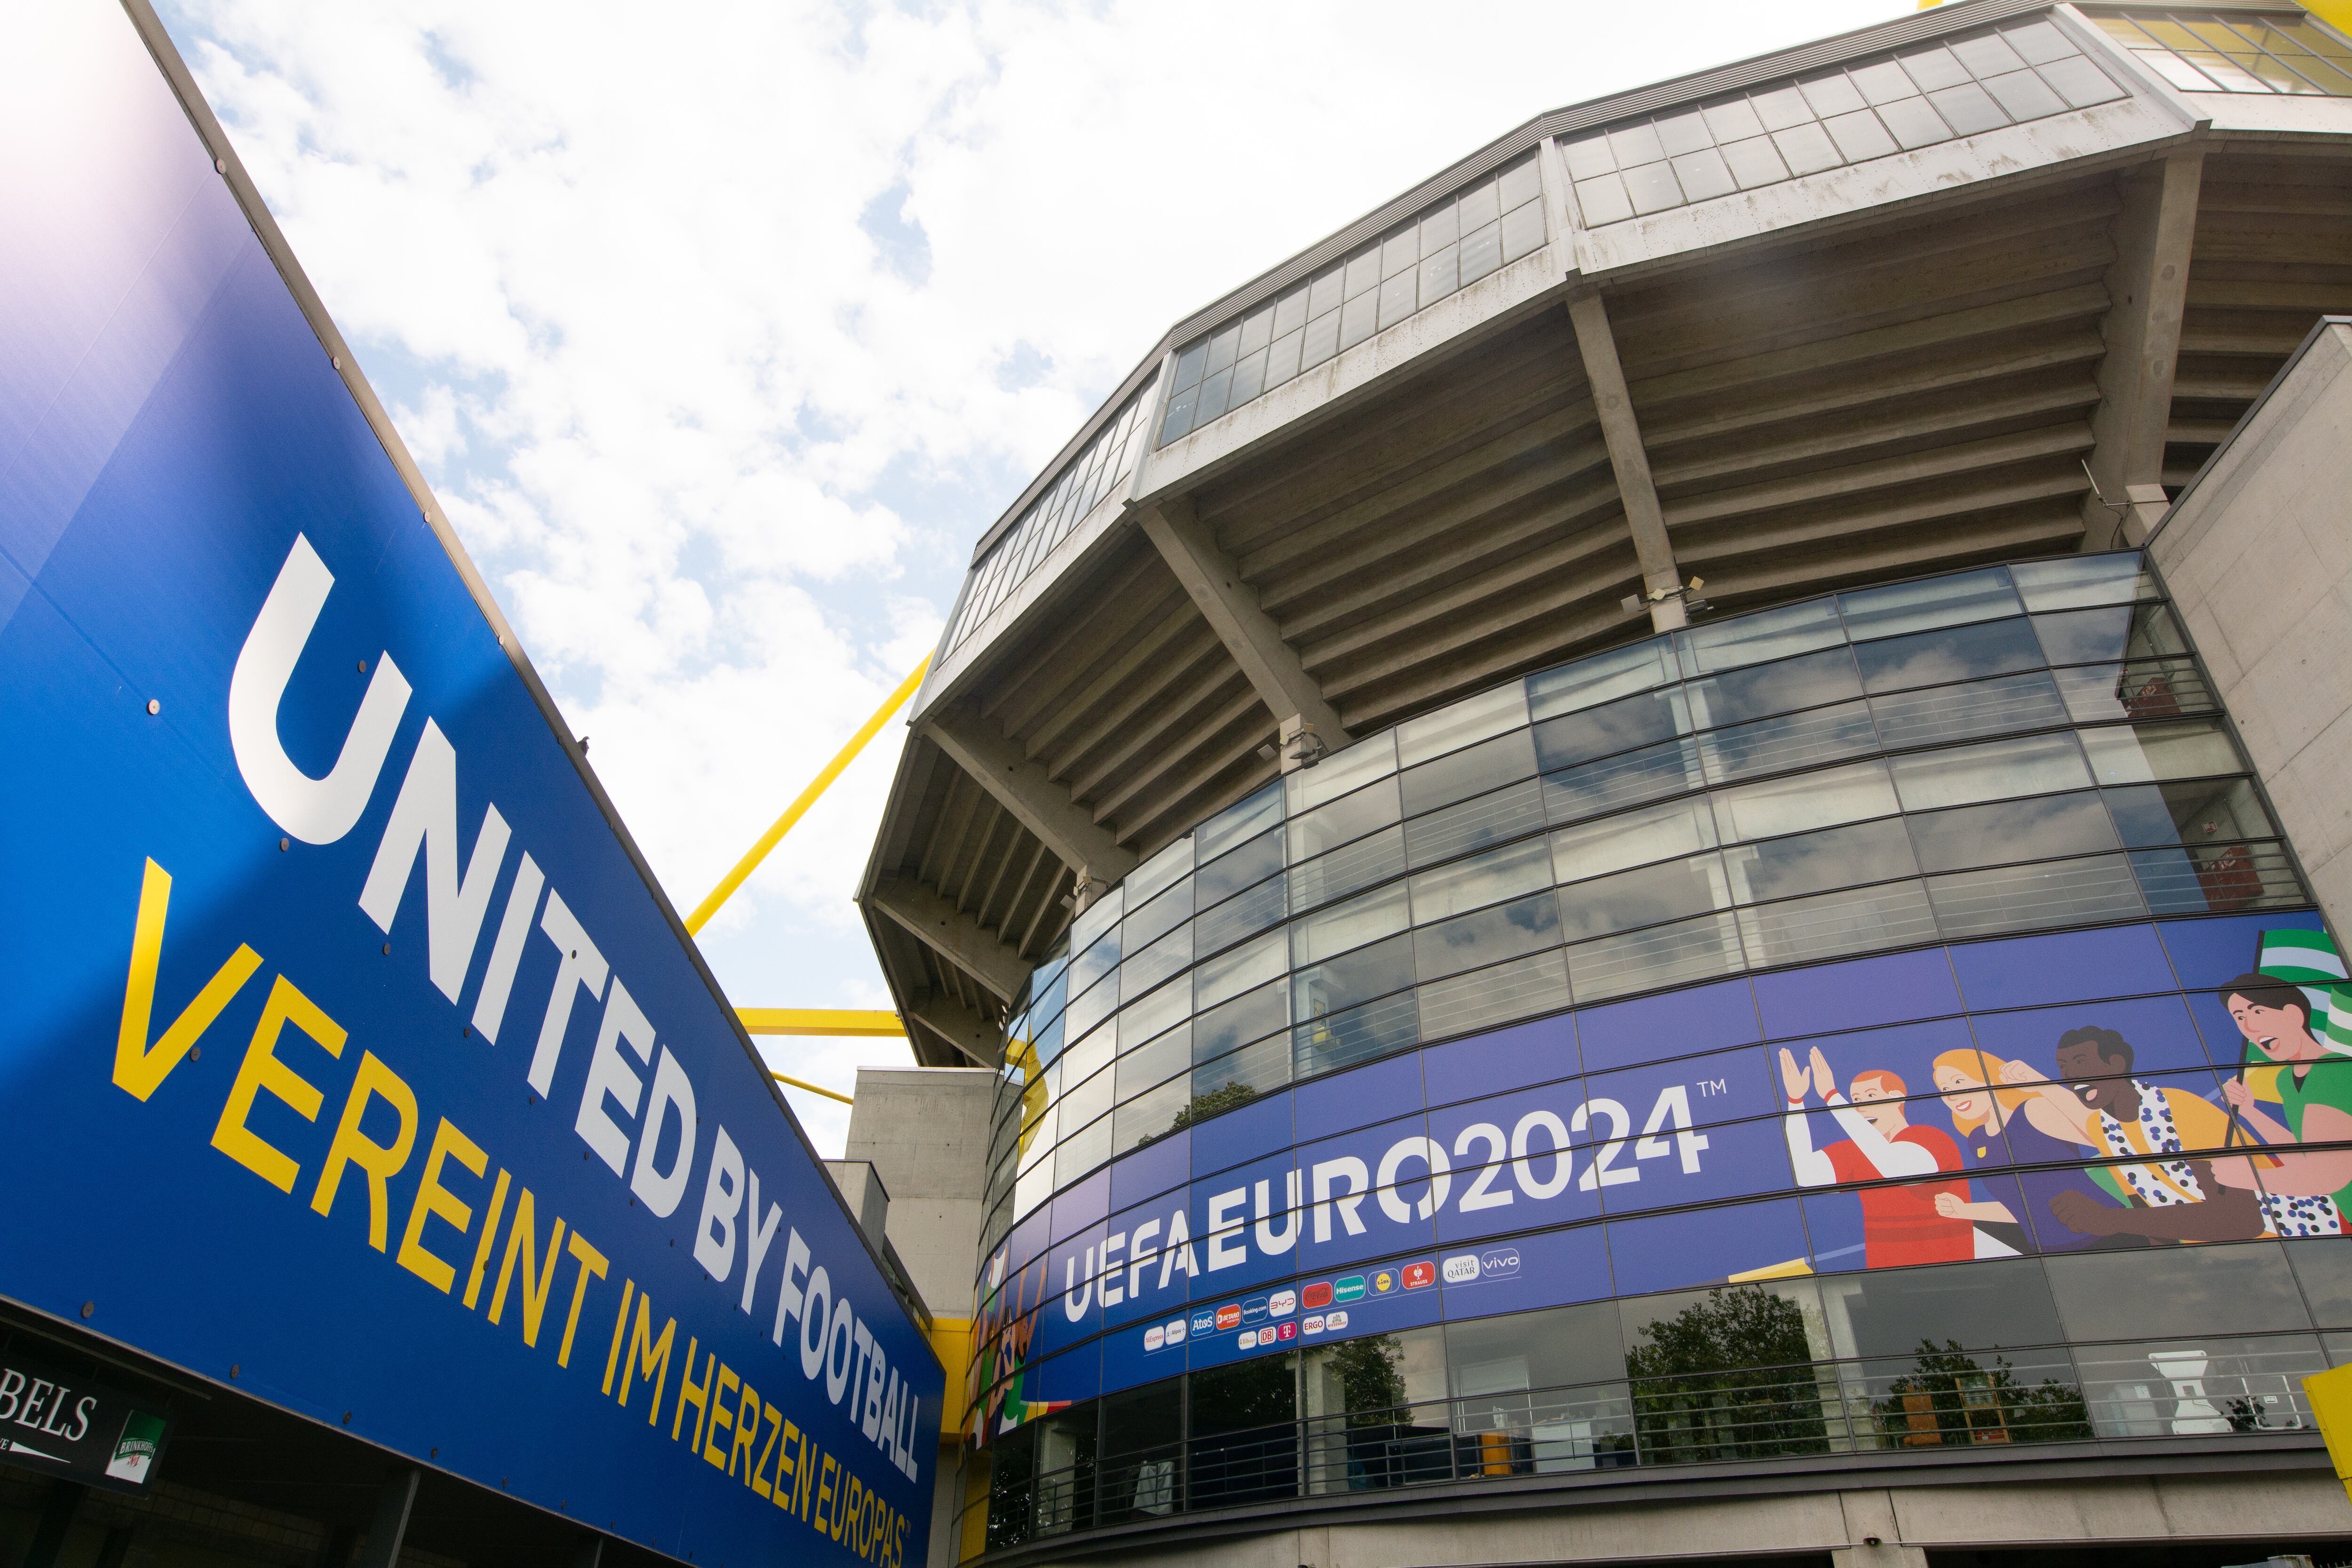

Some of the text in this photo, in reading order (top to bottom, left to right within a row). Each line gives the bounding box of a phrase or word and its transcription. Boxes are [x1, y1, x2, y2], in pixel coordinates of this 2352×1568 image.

[229, 532, 918, 1484] UNITED BY FOOTBALL
[112, 856, 610, 1369] VEREINT
[602, 1278, 677, 1427] IM
[672, 1337, 818, 1523] HERZEN
[815, 1451, 905, 1568] EUROPAS
[1065, 1210, 1200, 1322] UEFA
[1455, 1259, 1475, 1269] visit
[1483, 1257, 1518, 1269] vivo
[1447, 1266, 1476, 1278] QATAR
[1336, 1284, 1364, 1295] Hisense
[1271, 1297, 1295, 1310] BYD
[1243, 1305, 1267, 1315] Booking.com
[1223, 1312, 1240, 1321] BETANO
[1304, 1321, 1323, 1330] ERGO
[1145, 1334, 1164, 1344] AliExpress
[1262, 1331, 1272, 1341] DB
[0, 1368, 97, 1441] BELS
